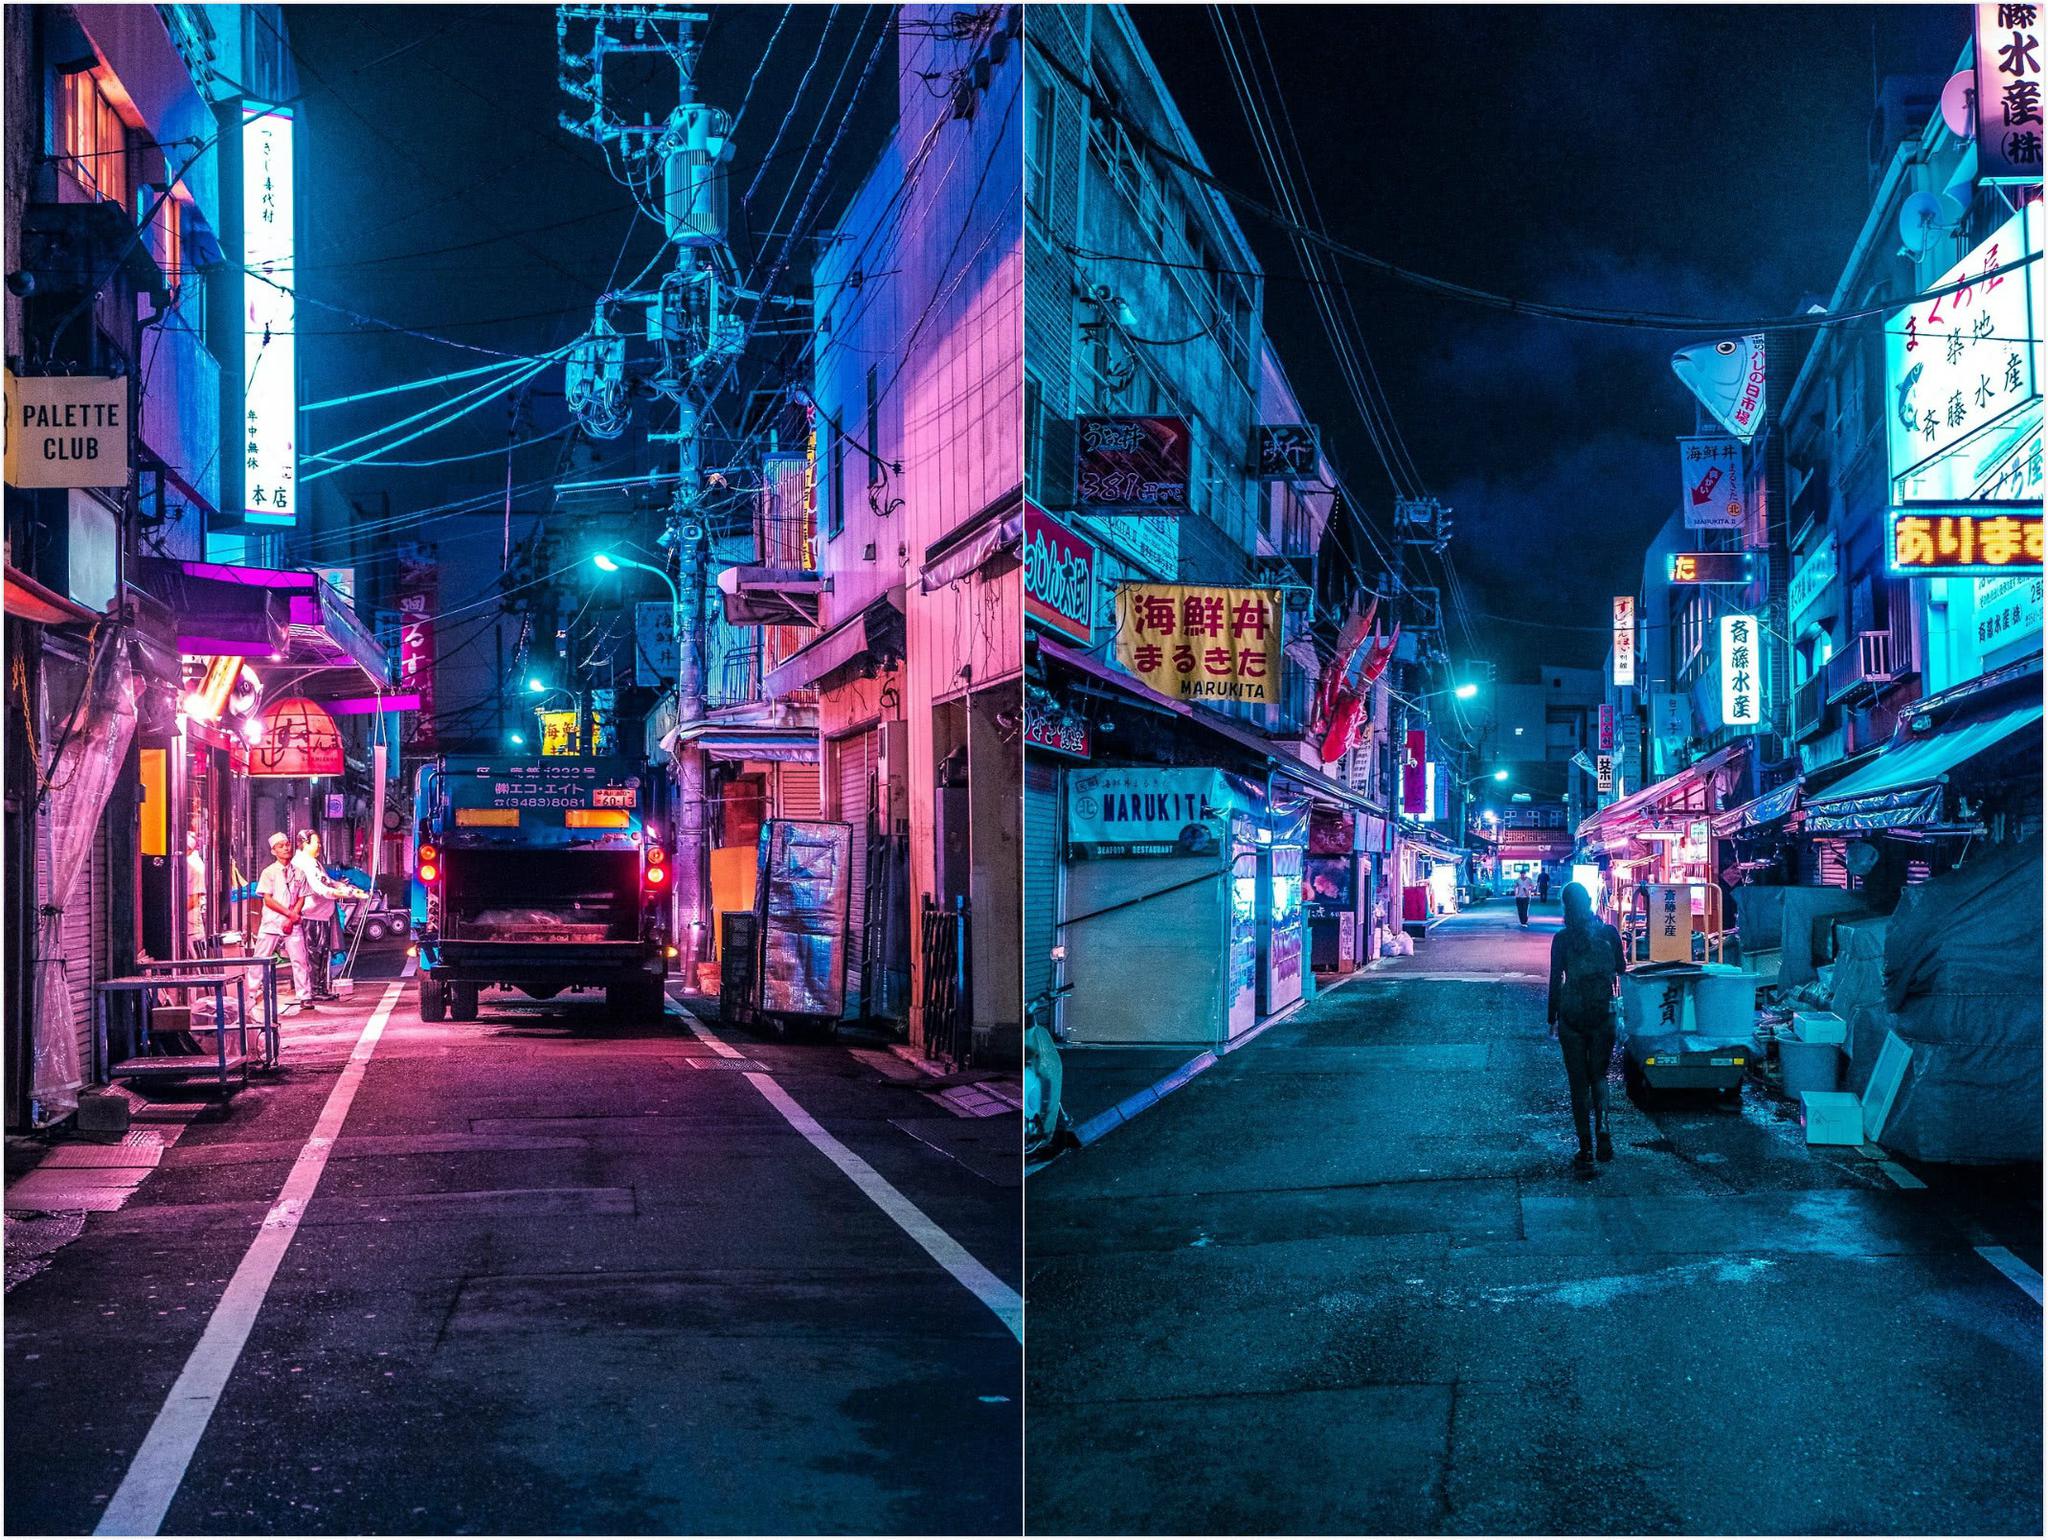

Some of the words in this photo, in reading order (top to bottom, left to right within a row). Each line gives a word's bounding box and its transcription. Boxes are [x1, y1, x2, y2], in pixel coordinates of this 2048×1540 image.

[1947, 309, 1995, 366] 築地
[23, 404, 119, 427] PALETTE
[44, 437, 98, 460] CLUB
[247, 409, 258, 470] 年中無休
[252, 484, 287, 508] 本店
[1135, 594, 1269, 640] 海鮮丼
[1134, 644, 1267, 677] まるきた
[1181, 680, 1264, 698] MARUKITA
[1104, 793, 1212, 822] MARUKITA
